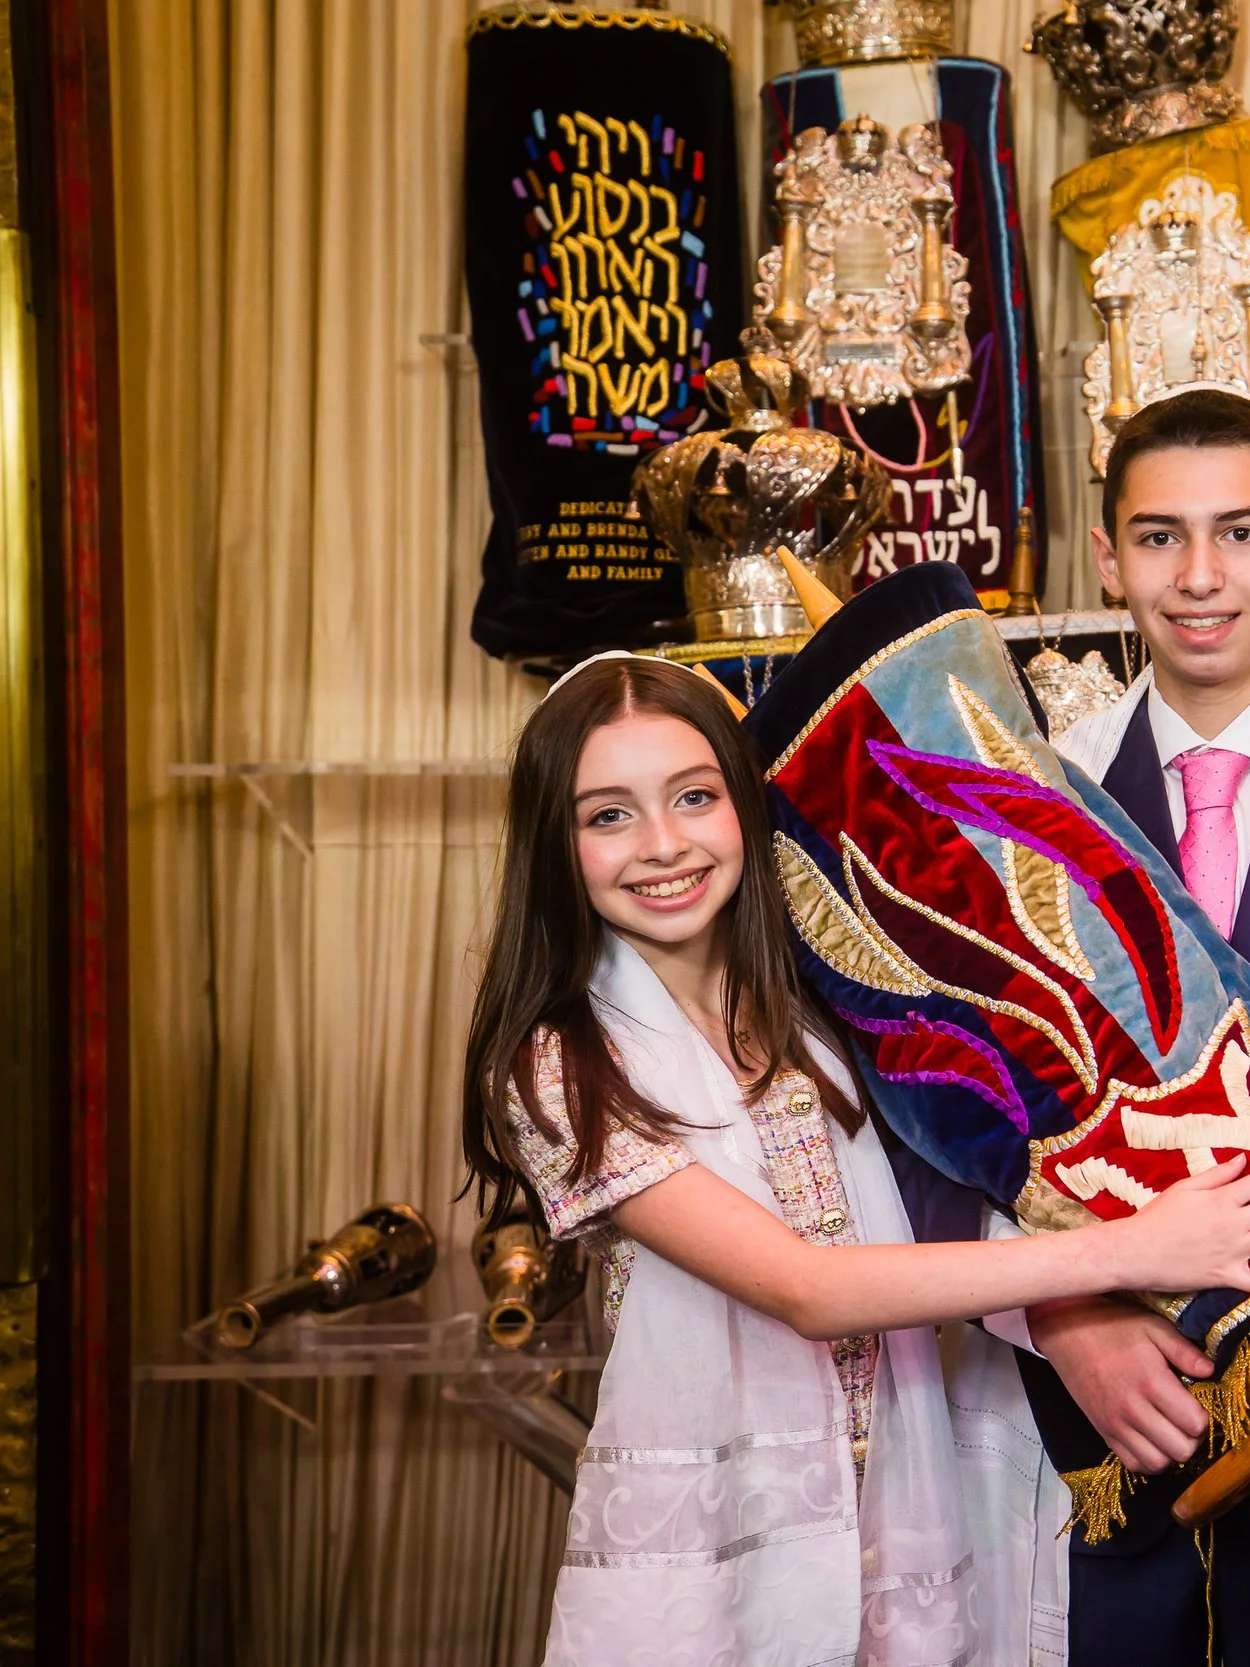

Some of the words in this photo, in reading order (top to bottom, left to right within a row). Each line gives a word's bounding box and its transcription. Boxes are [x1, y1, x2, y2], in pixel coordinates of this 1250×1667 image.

[557, 110, 650, 177] ויהי
[549, 172, 681, 246] בנסוע
[551, 296, 687, 364] ויאמר
[561, 352, 670, 417] משה
[559, 501, 626, 517] DEDICAT
[547, 523, 582, 538] AND
[586, 523, 649, 540] BRENDA
[555, 544, 590, 559] AND
[594, 544, 648, 560] RANDY
[653, 549, 682, 563] GL
[566, 565, 602, 580] AND
[606, 566, 664, 581] FAMILY
